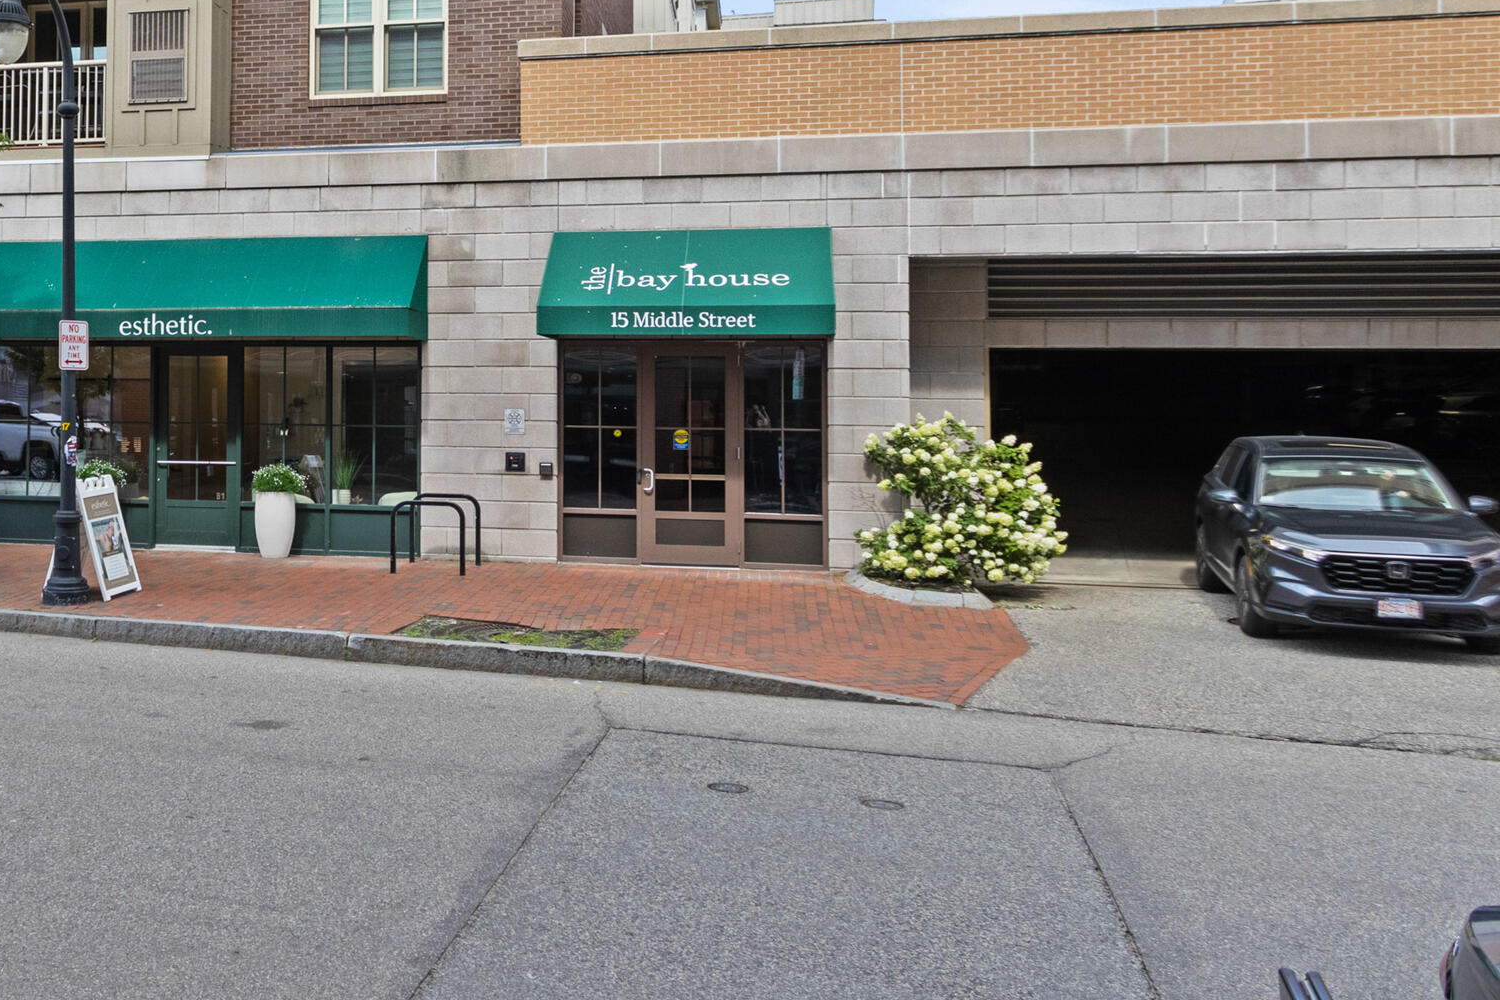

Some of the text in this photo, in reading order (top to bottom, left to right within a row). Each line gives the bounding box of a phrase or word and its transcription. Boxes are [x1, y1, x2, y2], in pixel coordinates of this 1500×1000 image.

[581, 266, 790, 291] the bay house
[119, 313, 212, 336] esthetic.
[611, 312, 756, 328] 15 Middle Street
[68, 325, 79, 333] NO
[62, 335, 86, 344] PARKING
[61, 422, 71, 431] 17
